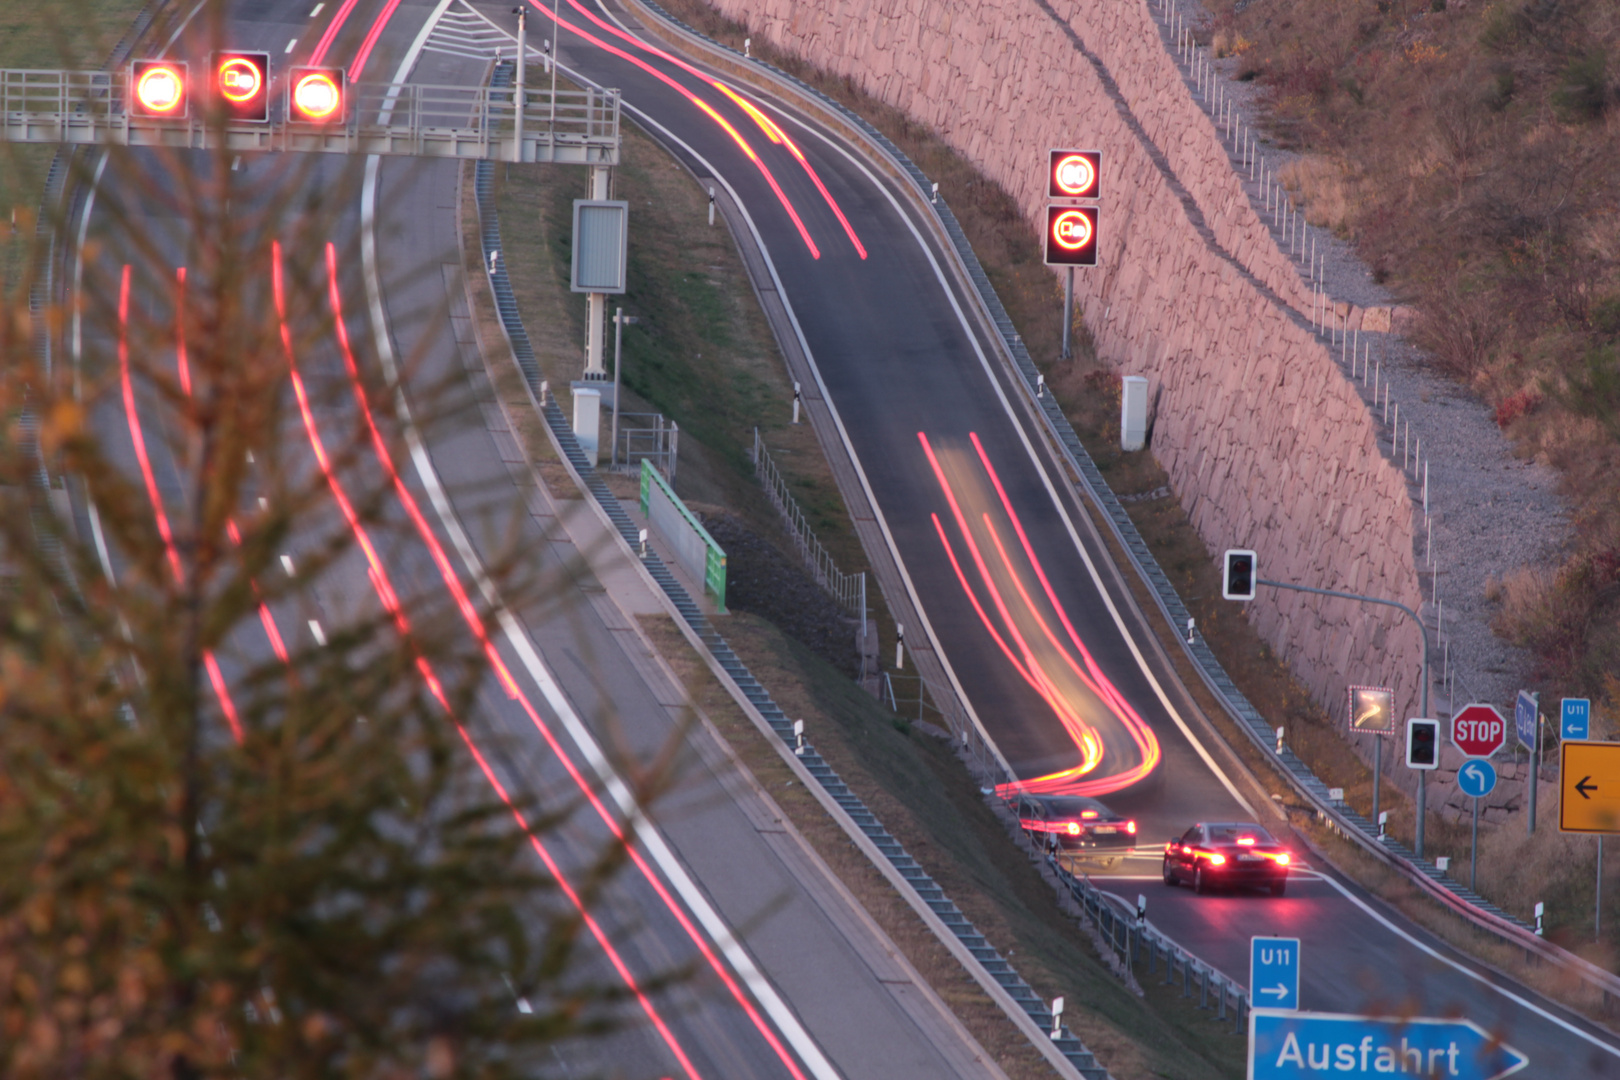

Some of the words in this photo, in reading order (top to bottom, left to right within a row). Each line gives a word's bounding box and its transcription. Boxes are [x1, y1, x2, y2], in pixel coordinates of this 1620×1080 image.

[1567, 705, 1584, 715] U11
[1456, 720, 1501, 742] STOP
[1261, 948, 1290, 965] U11
[1275, 1031, 1460, 1076] Ausfahrt
